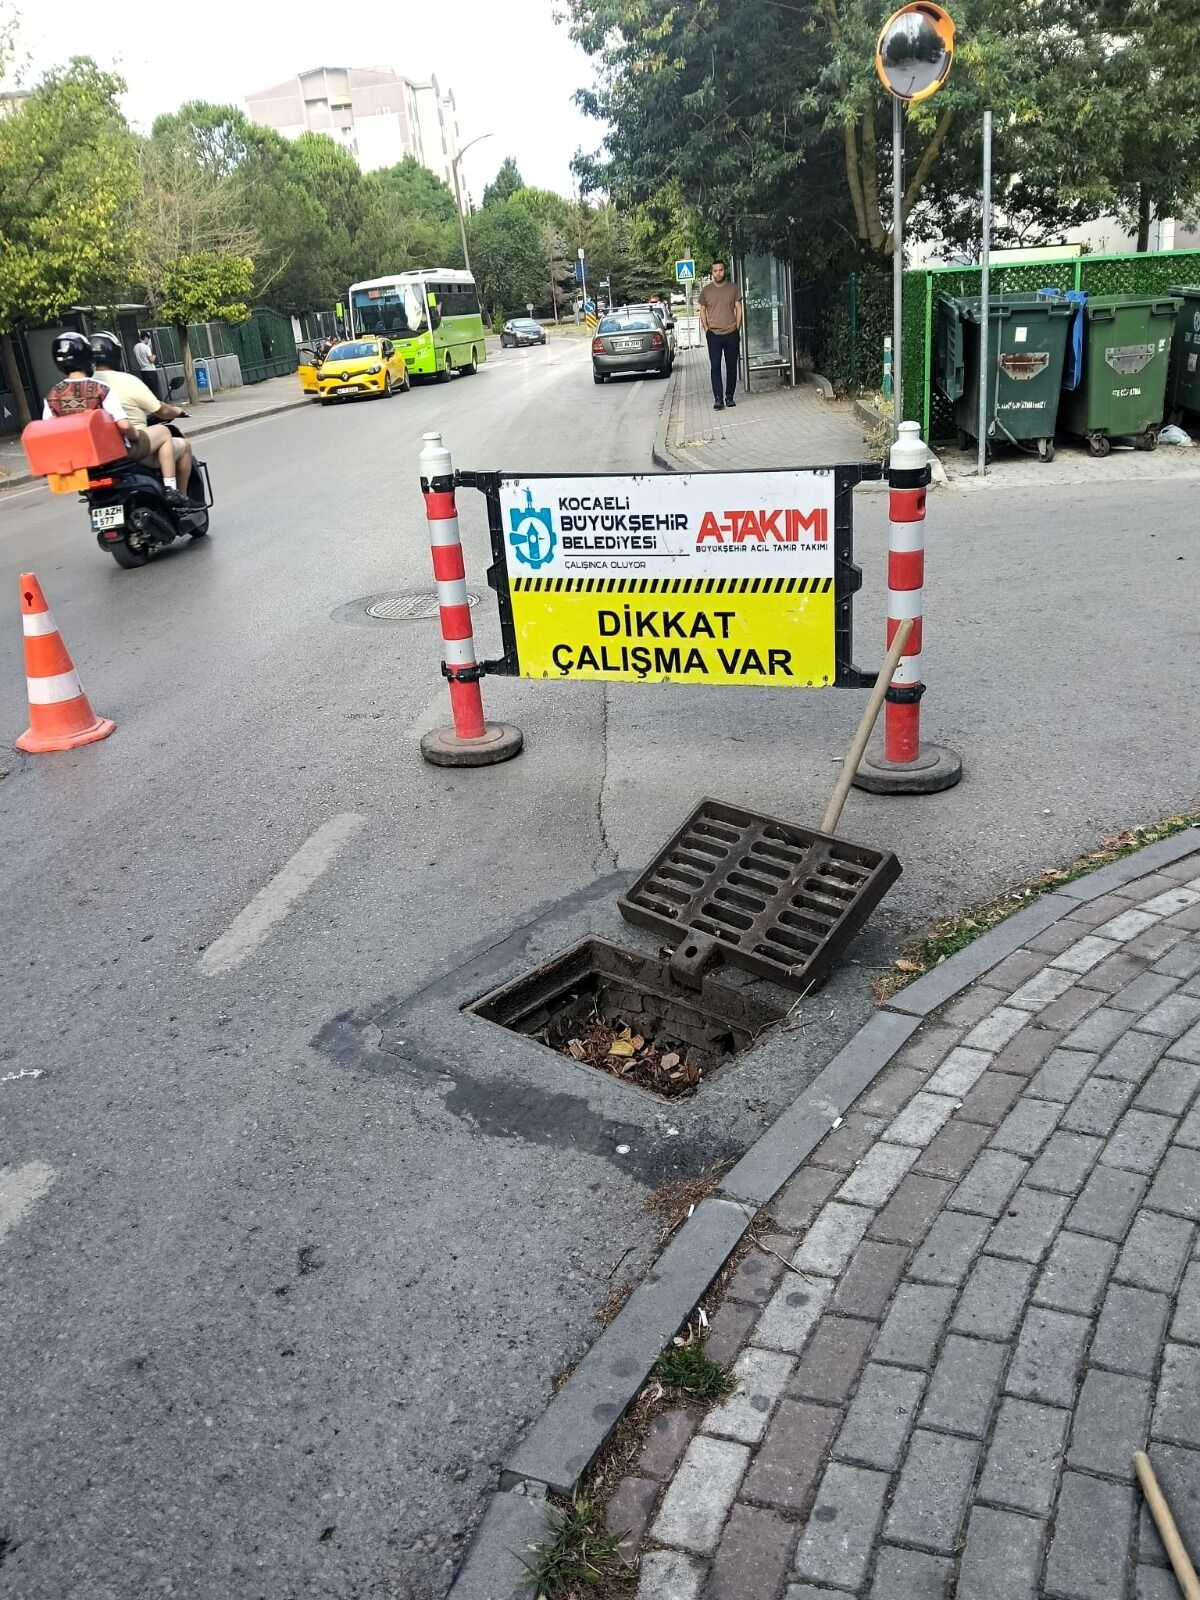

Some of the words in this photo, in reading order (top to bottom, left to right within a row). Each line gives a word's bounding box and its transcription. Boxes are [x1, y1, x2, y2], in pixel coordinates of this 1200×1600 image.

[558, 496, 630, 510] KOCAELİ
[105, 506, 122, 516] AZH
[100, 516, 115, 525] 577
[560, 513, 688, 533] BÜYÜKŞEHİR
[696, 508, 828, 543] A-TAKIMI
[562, 536, 657, 549] BELEDİYESİ
[750, 544, 770, 552] ACİL
[773, 544, 797, 552] TAMİR
[801, 543, 828, 551] TAKIMI
[564, 561, 608, 570] ÇALIŞINCA
[610, 561, 646, 569] OLUYOR
[597, 604, 736, 639] DİKKAT
[552, 644, 709, 678] ÇALIŞMA
[717, 648, 794, 676] VAR
